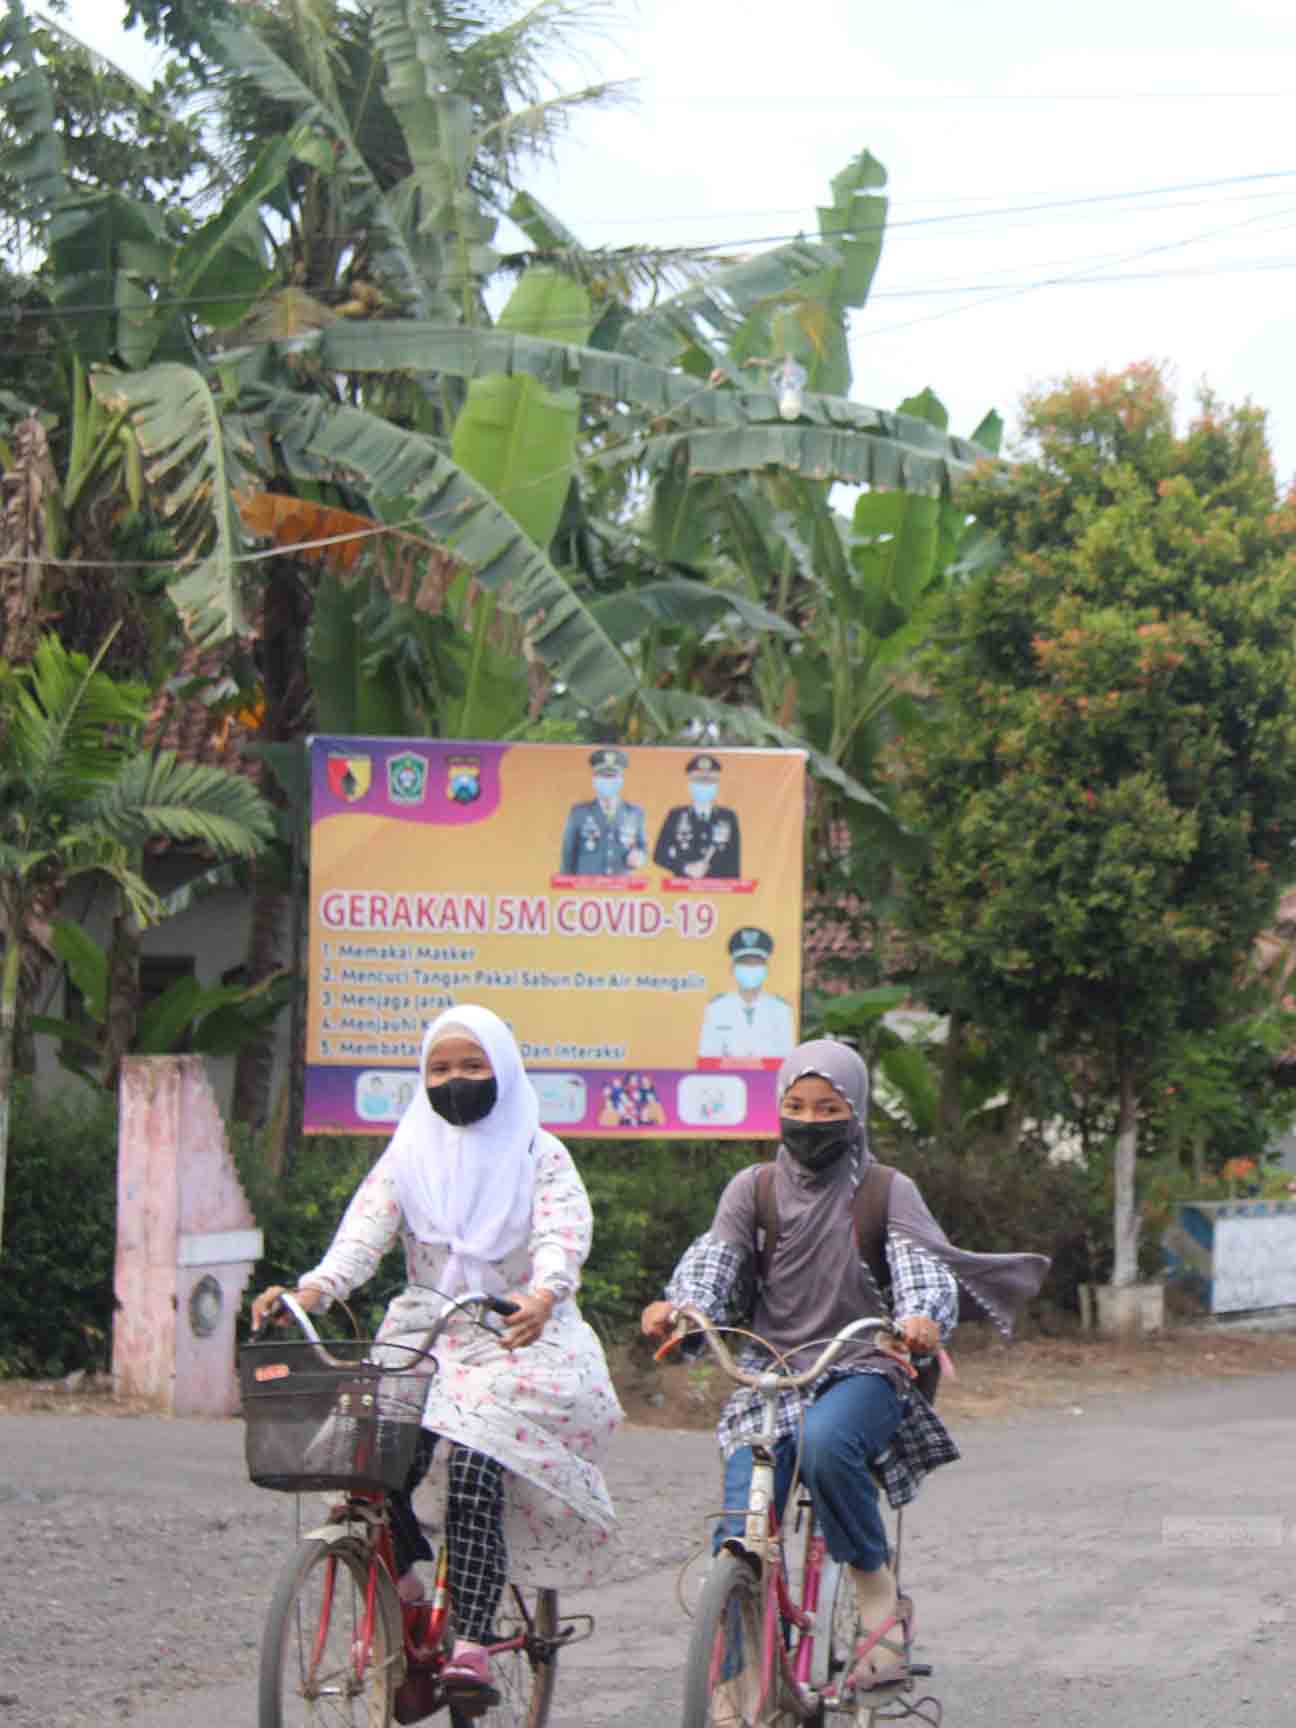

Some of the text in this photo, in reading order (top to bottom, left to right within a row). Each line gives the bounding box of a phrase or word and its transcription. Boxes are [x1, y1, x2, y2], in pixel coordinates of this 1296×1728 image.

[322, 894, 714, 934] GERAKAN 5M COVID-19
[338, 943, 412, 961] Memakai
[416, 945, 475, 961] Masker
[342, 968, 408, 985] Mencuci
[413, 968, 471, 989] Tangan
[475, 970, 517, 986] Pakai
[522, 970, 571, 986] Sabun
[574, 972, 604, 987] Dan
[342, 992, 410, 1012] Menjaga
[341, 1016, 416, 1034] Menjauhi
[520, 1043, 550, 1058] Dan
